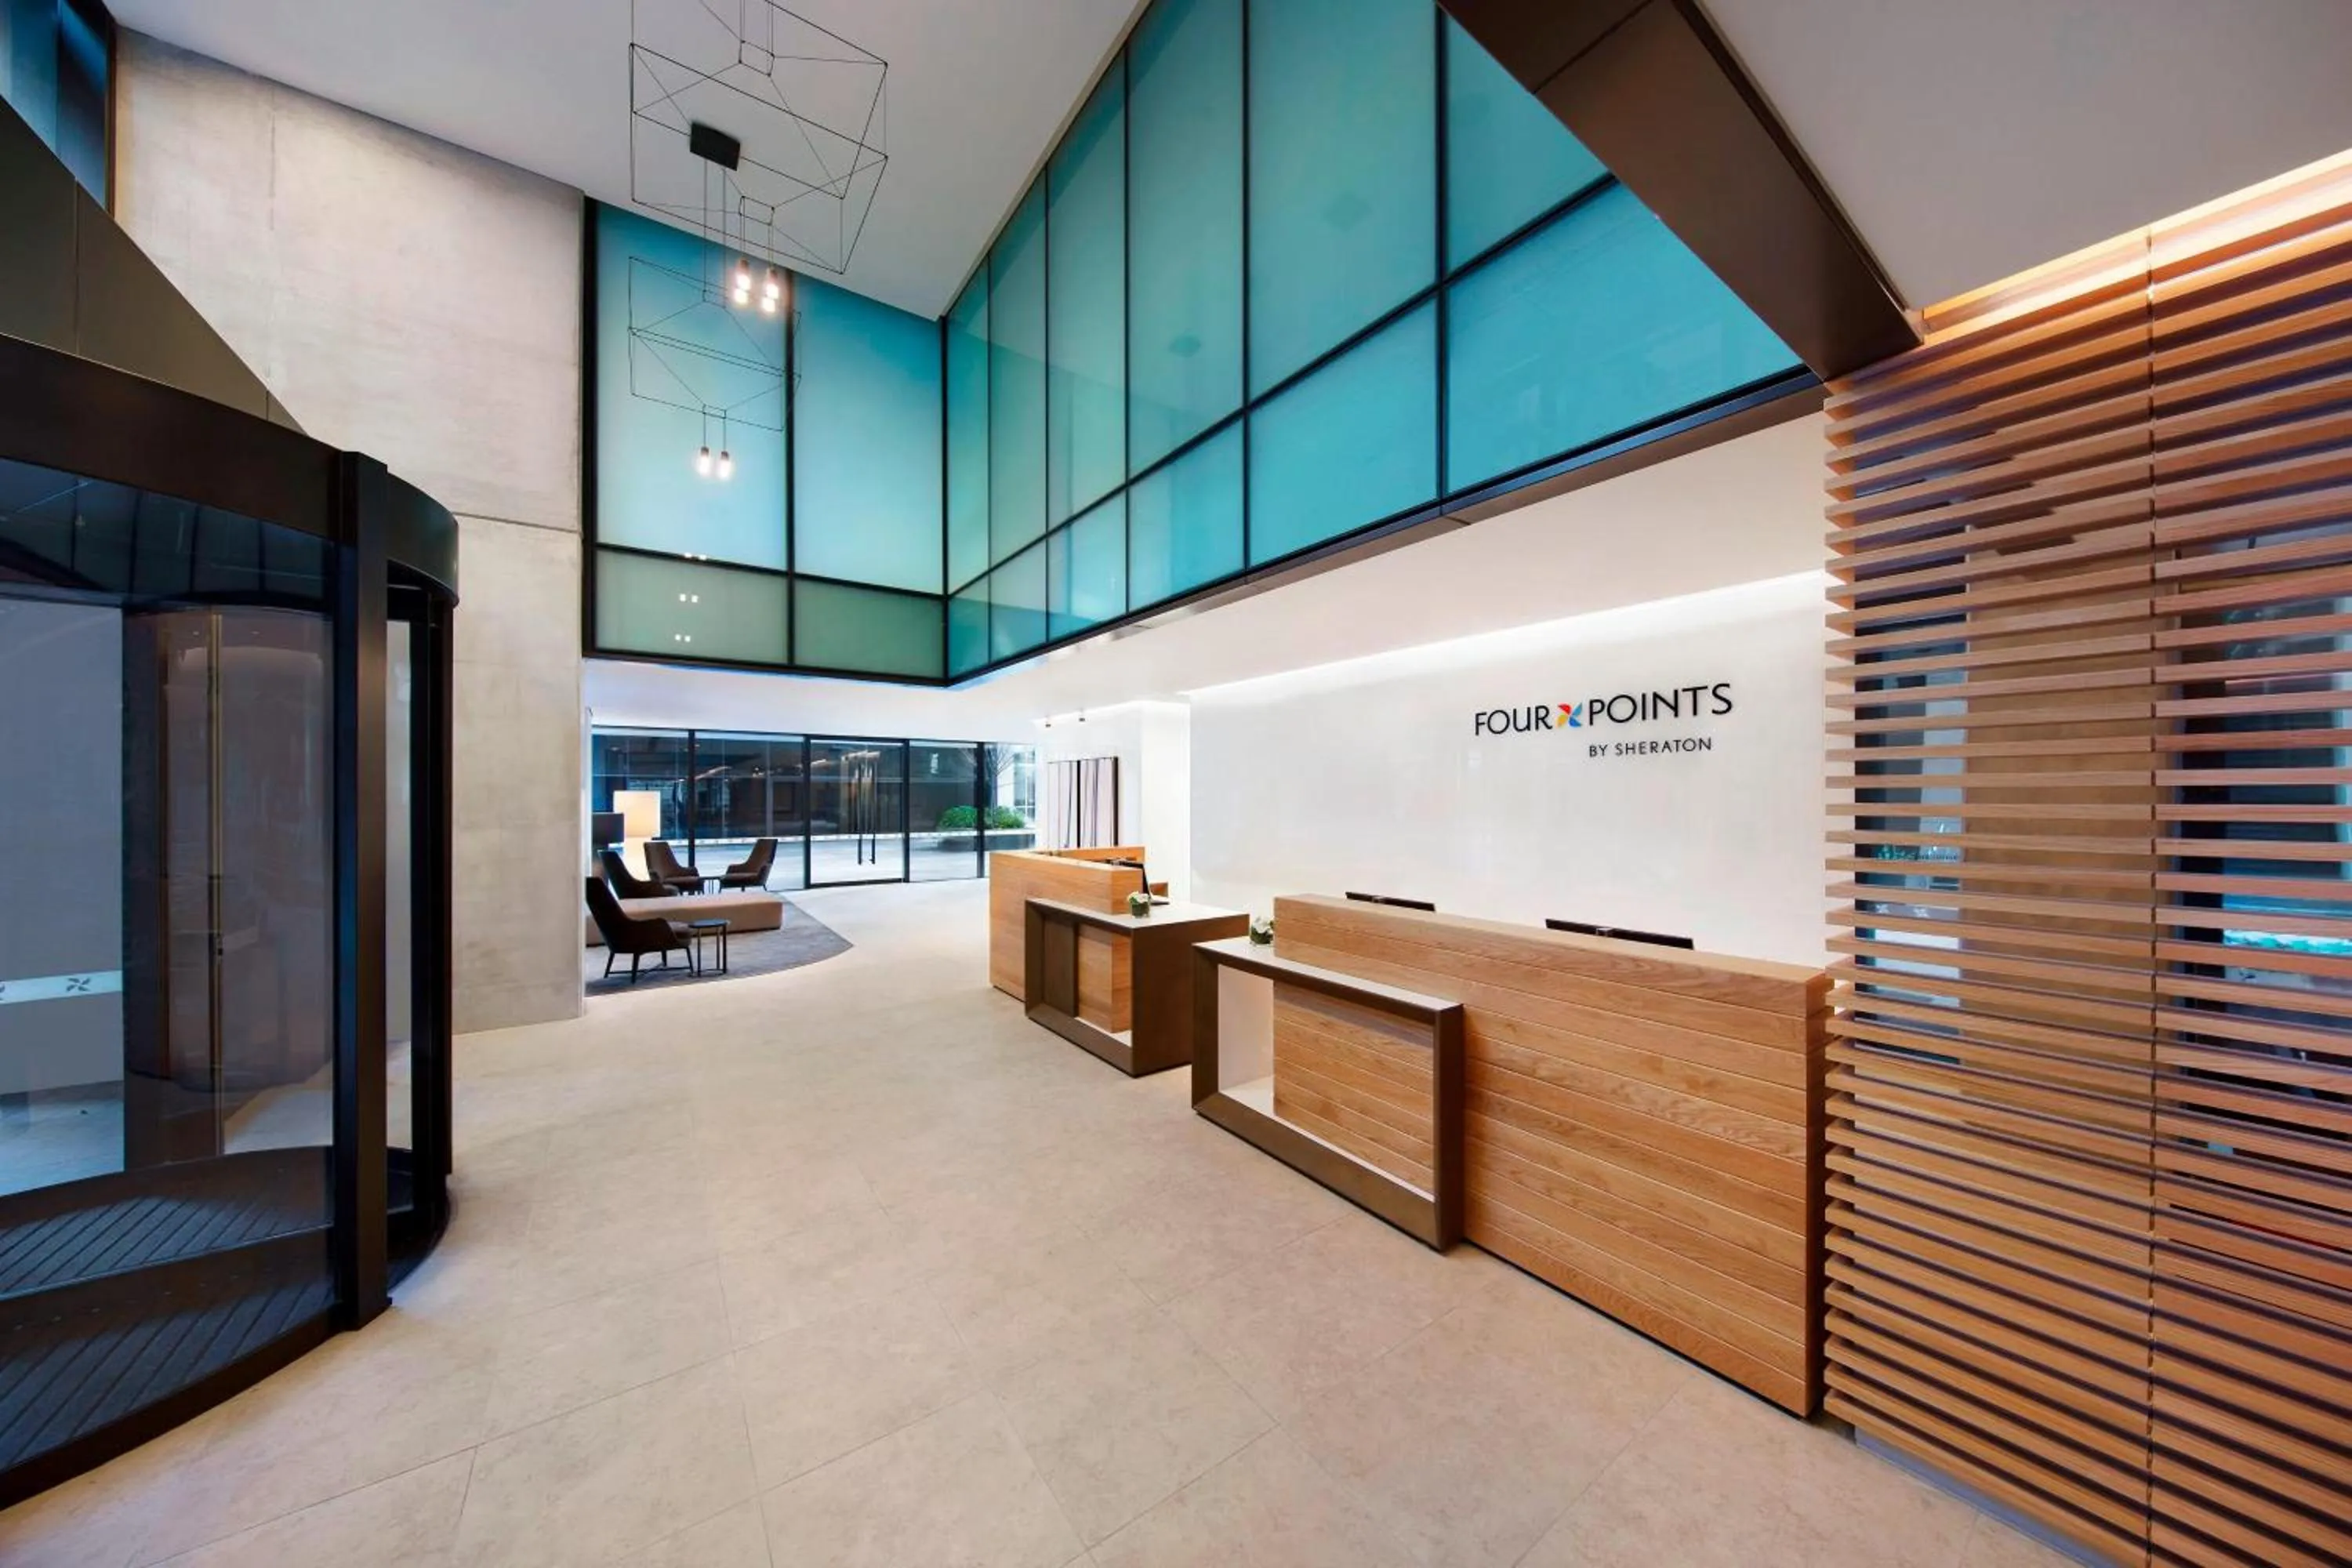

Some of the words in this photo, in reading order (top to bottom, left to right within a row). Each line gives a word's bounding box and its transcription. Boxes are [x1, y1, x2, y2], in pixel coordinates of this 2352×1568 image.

[1475, 705, 1553, 736] FOUR
[1588, 683, 1733, 727] POINTS
[1589, 744, 1608, 758] BY
[1614, 737, 1712, 756] SHERATON
